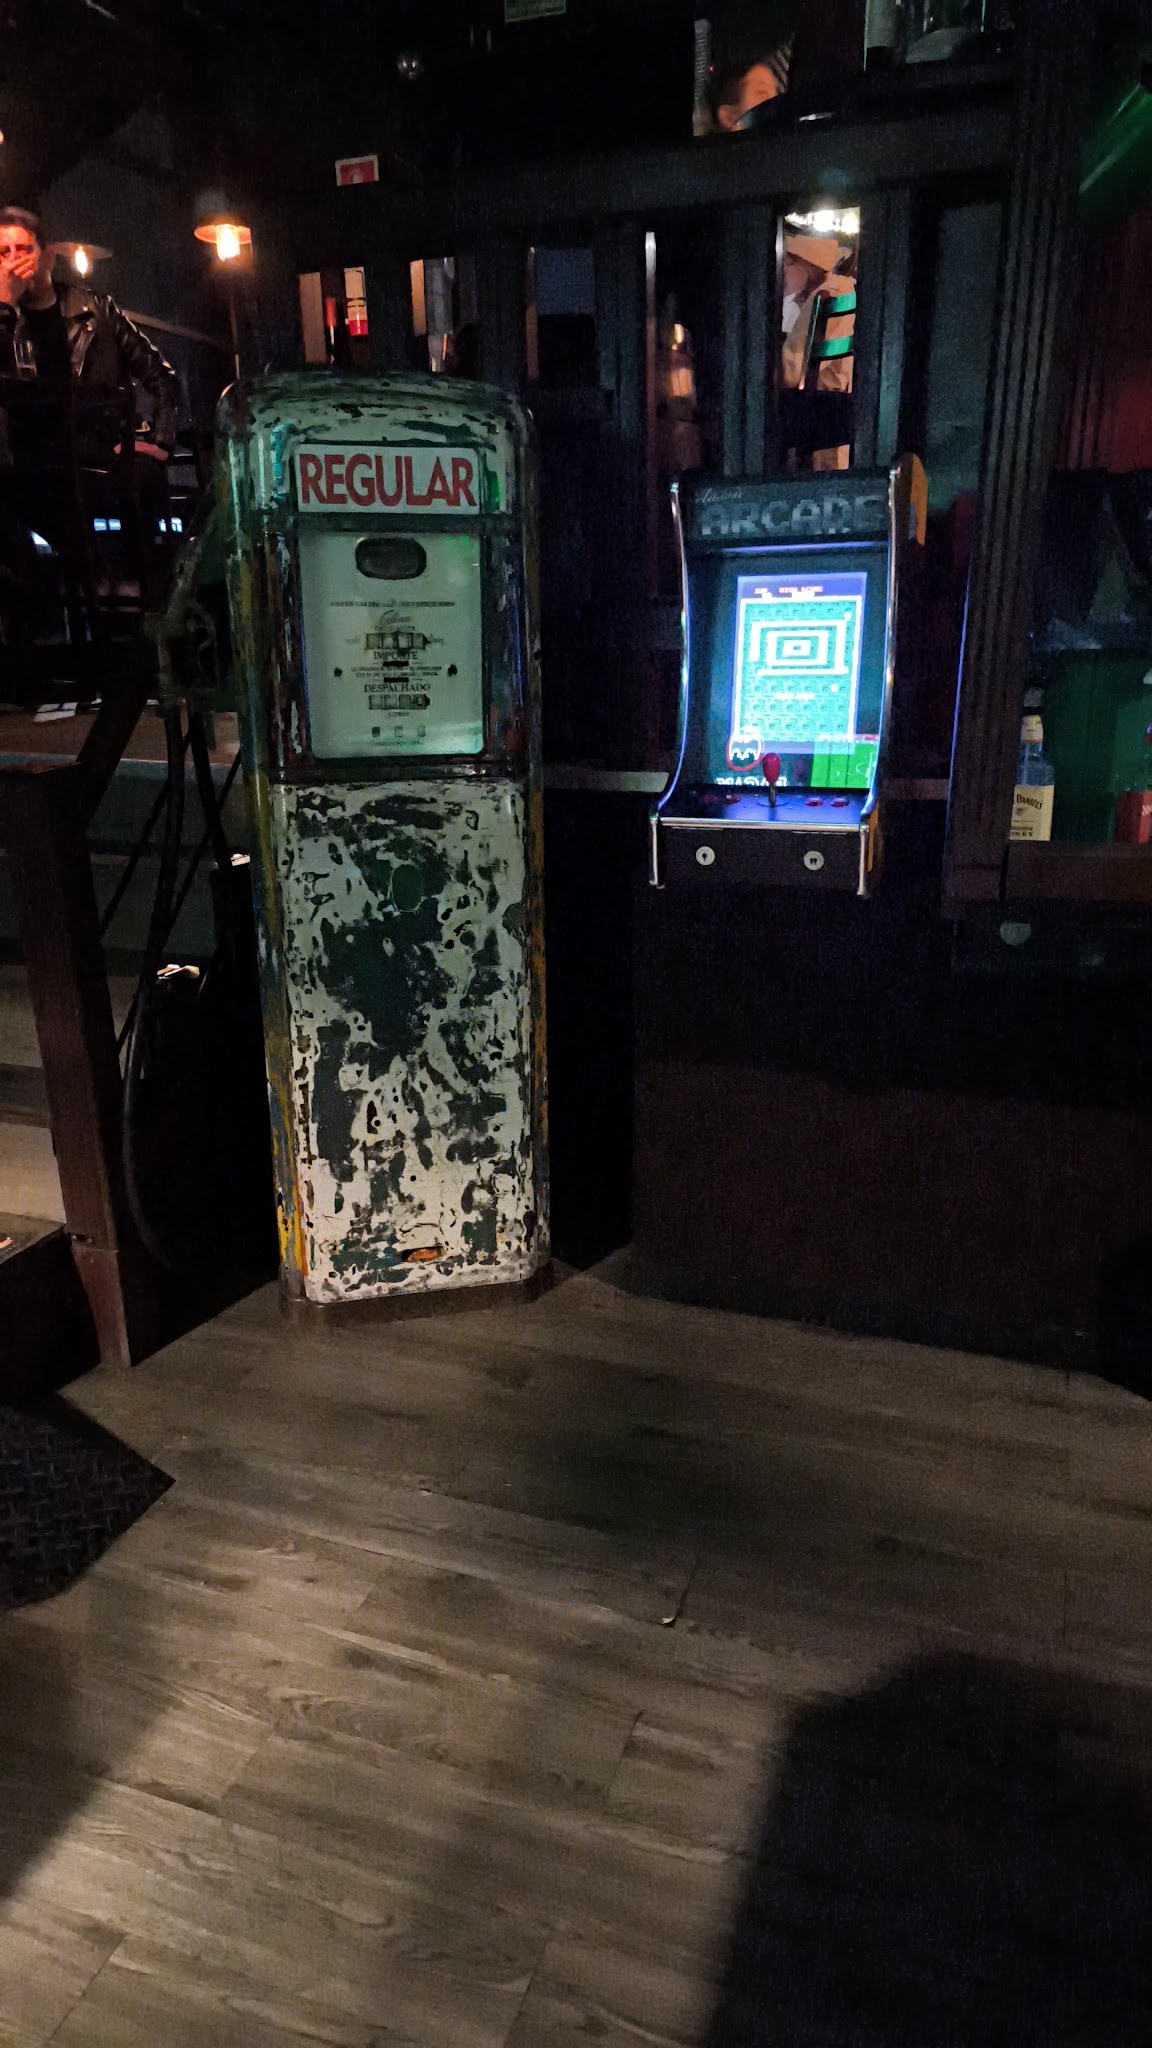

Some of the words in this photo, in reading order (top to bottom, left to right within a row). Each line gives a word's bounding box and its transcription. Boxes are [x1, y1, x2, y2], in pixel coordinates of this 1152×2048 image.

[299, 454, 477, 507] REGULAR
[373, 651, 419, 660] IMPOTE
[364, 683, 431, 693] DESPACHADO
